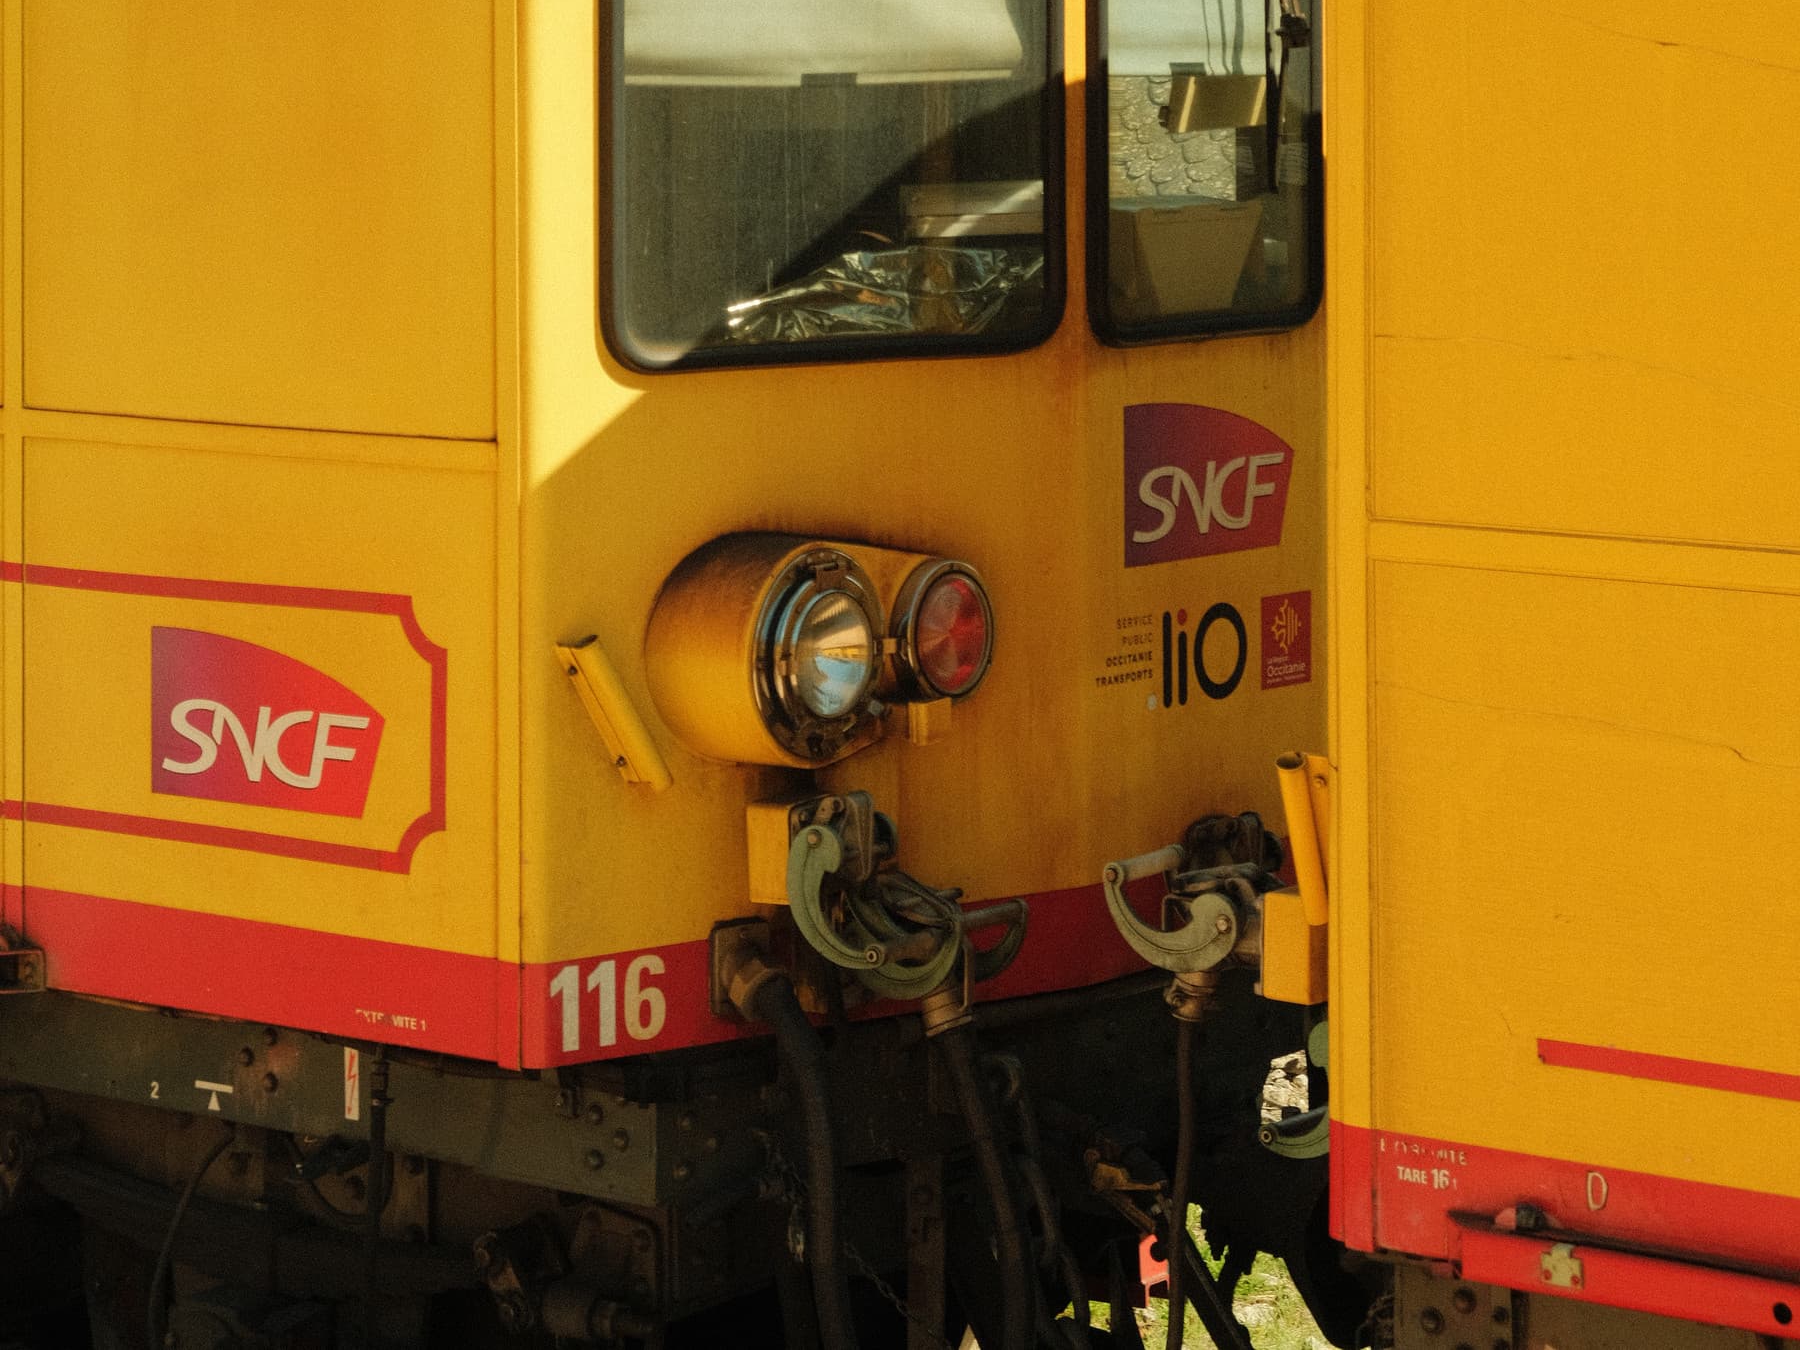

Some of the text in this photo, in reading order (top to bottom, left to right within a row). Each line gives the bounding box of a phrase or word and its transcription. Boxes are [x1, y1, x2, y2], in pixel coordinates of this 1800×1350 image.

[1132, 452, 1285, 544] SNCF
[1116, 614, 1153, 630] SERVICE
[1122, 632, 1153, 646] PUBLIC
[1105, 651, 1153, 668] OCCITANIE
[1095, 669, 1153, 688] TRANSPORTS
[161, 699, 370, 789] SNCF
[549, 954, 667, 1053] 116
[150, 1081, 160, 1099] 2
[1396, 1165, 1428, 1185] TARE
[1431, 1168, 1450, 1190] 16
[1587, 1171, 1608, 1211] D
